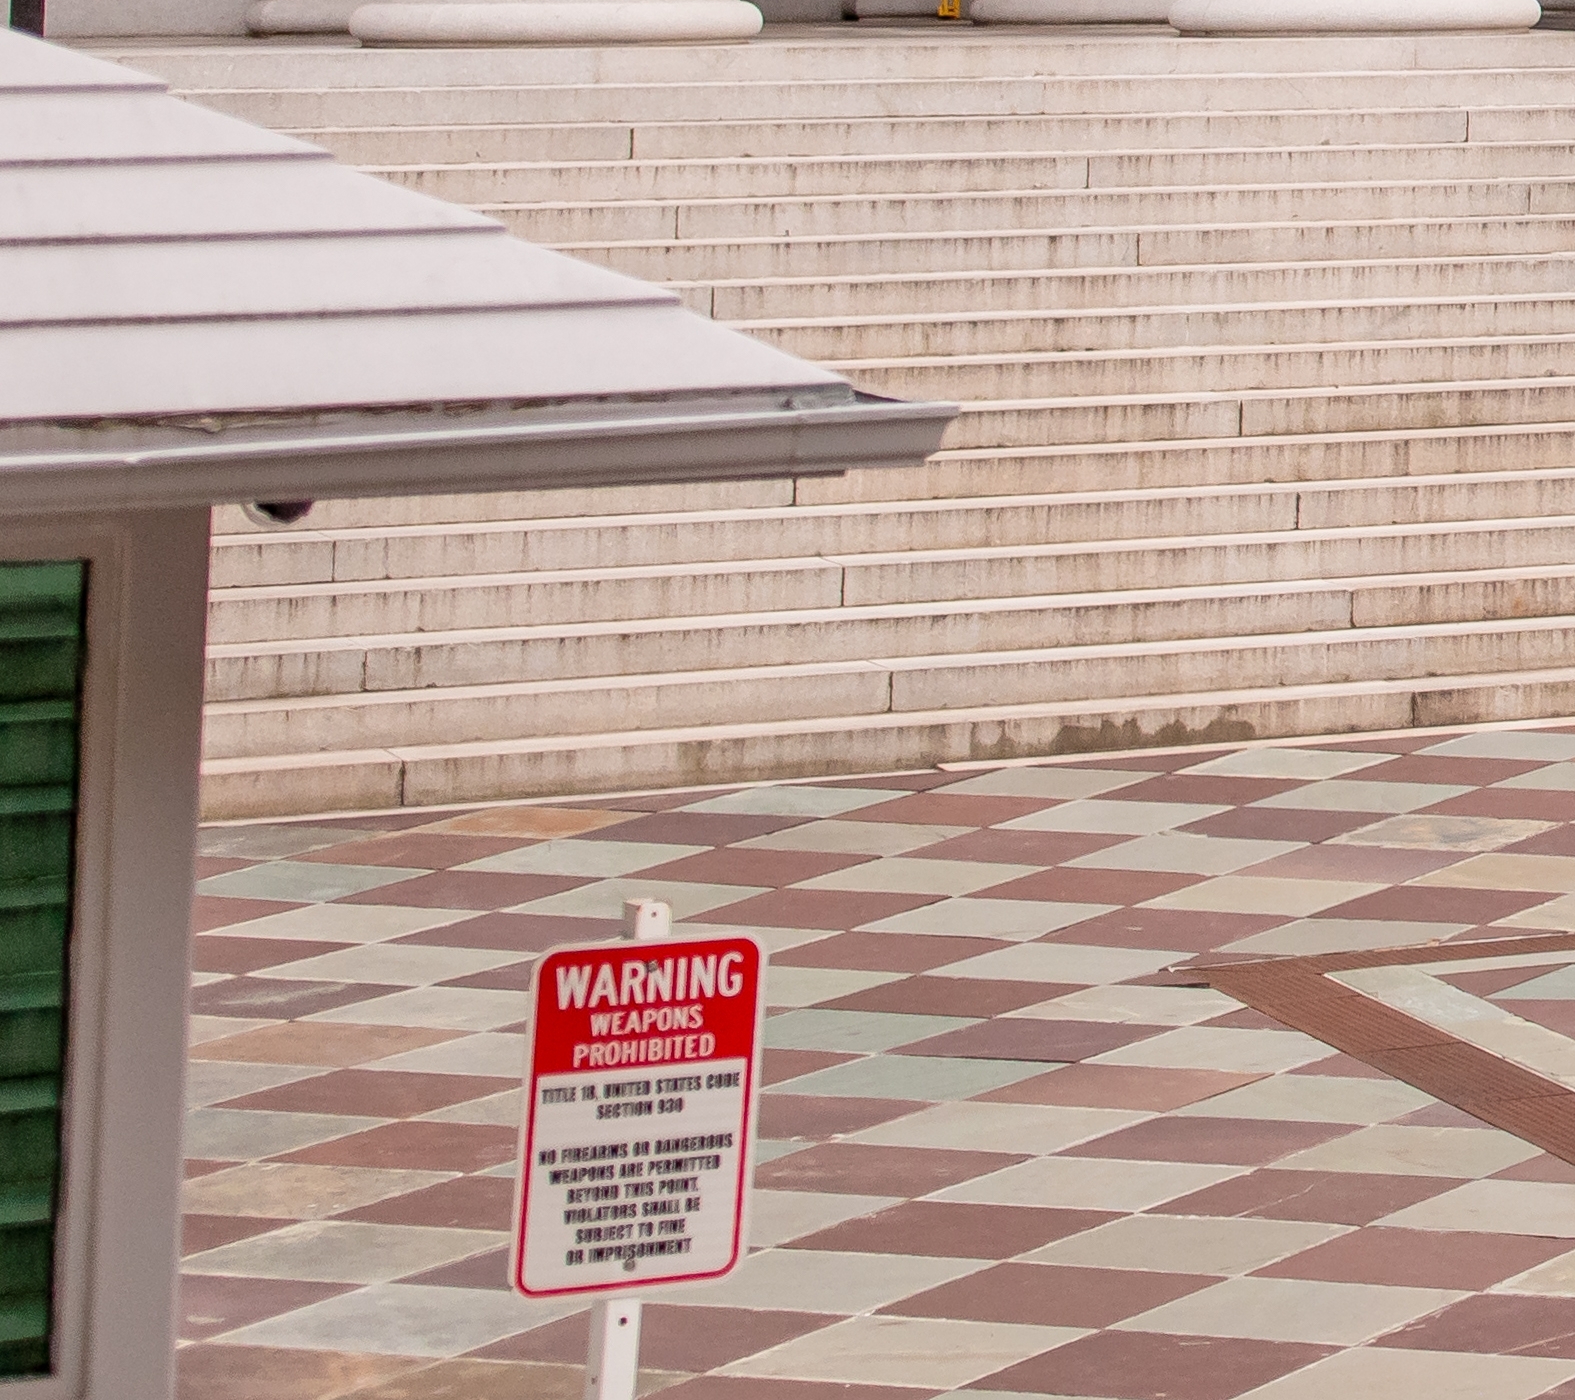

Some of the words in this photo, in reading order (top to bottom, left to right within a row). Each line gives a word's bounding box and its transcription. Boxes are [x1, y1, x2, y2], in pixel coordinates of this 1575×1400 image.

[555, 950, 744, 1010] WARNING
[590, 1003, 704, 1037] WEAPONS
[573, 1032, 716, 1068] PROHIBITED
[541, 1087, 575, 1104] TITLE
[603, 1080, 651, 1099] UNITED
[655, 1076, 702, 1094] STATES
[706, 1071, 740, 1089] CODE
[595, 1100, 652, 1120] SECTION
[538, 1149, 557, 1166] NO
[561, 1143, 628, 1163] FIREARMS
[632, 1141, 650, 1157] OR
[654, 1133, 733, 1155] DANGEROUS
[549, 1165, 615, 1185] WEAPONS
[618, 1162, 643, 1179] ARE
[648, 1155, 720, 1176] PERMITTED
[566, 1185, 619, 1204] BEYOND
[624, 1181, 654, 1199] THIS
[563, 1203, 637, 1225] VIOLATORS
[641, 1199, 680, 1217] SHALL
[685, 1197, 701, 1213] BE
[575, 1224, 634, 1244] SUBJECT
[638, 1222, 654, 1238] TO
[658, 1218, 685, 1235] FINE
[565, 1249, 583, 1266] OR
[588, 1238, 692, 1263] IMPRISONMENT
